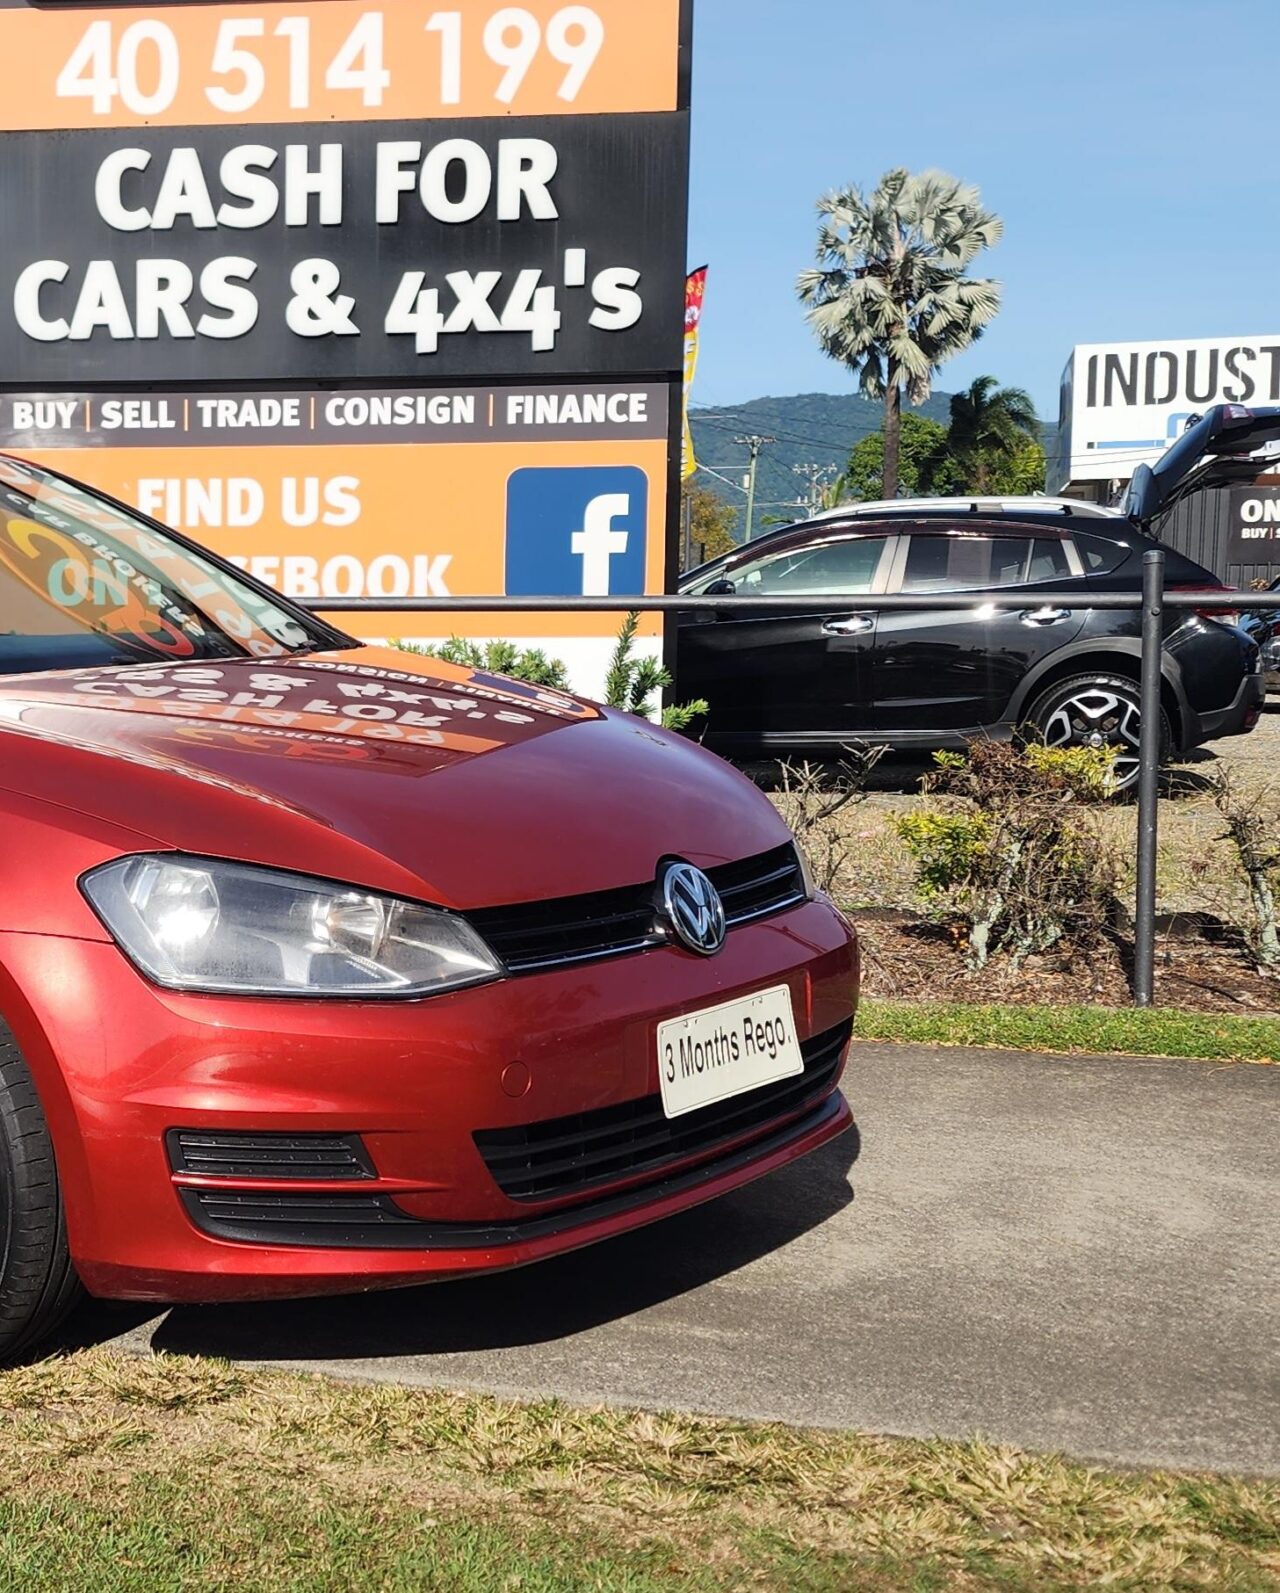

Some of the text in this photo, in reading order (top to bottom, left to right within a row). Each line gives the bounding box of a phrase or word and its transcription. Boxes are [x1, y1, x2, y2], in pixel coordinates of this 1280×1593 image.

[55, 5, 605, 115] 40 514 199
[95, 138, 559, 231] CASH FOR
[14, 256, 258, 341] CARS
[286, 258, 360, 338] &
[12, 393, 648, 430] BUY SELL TRADE CONSIGN FINANCE
[136, 475, 361, 528] FIND US
[1241, 528, 1268, 539] BUY
[47, 554, 454, 607] ON EBOOK
[665, 1016, 792, 1083] 3 Months Rego.
